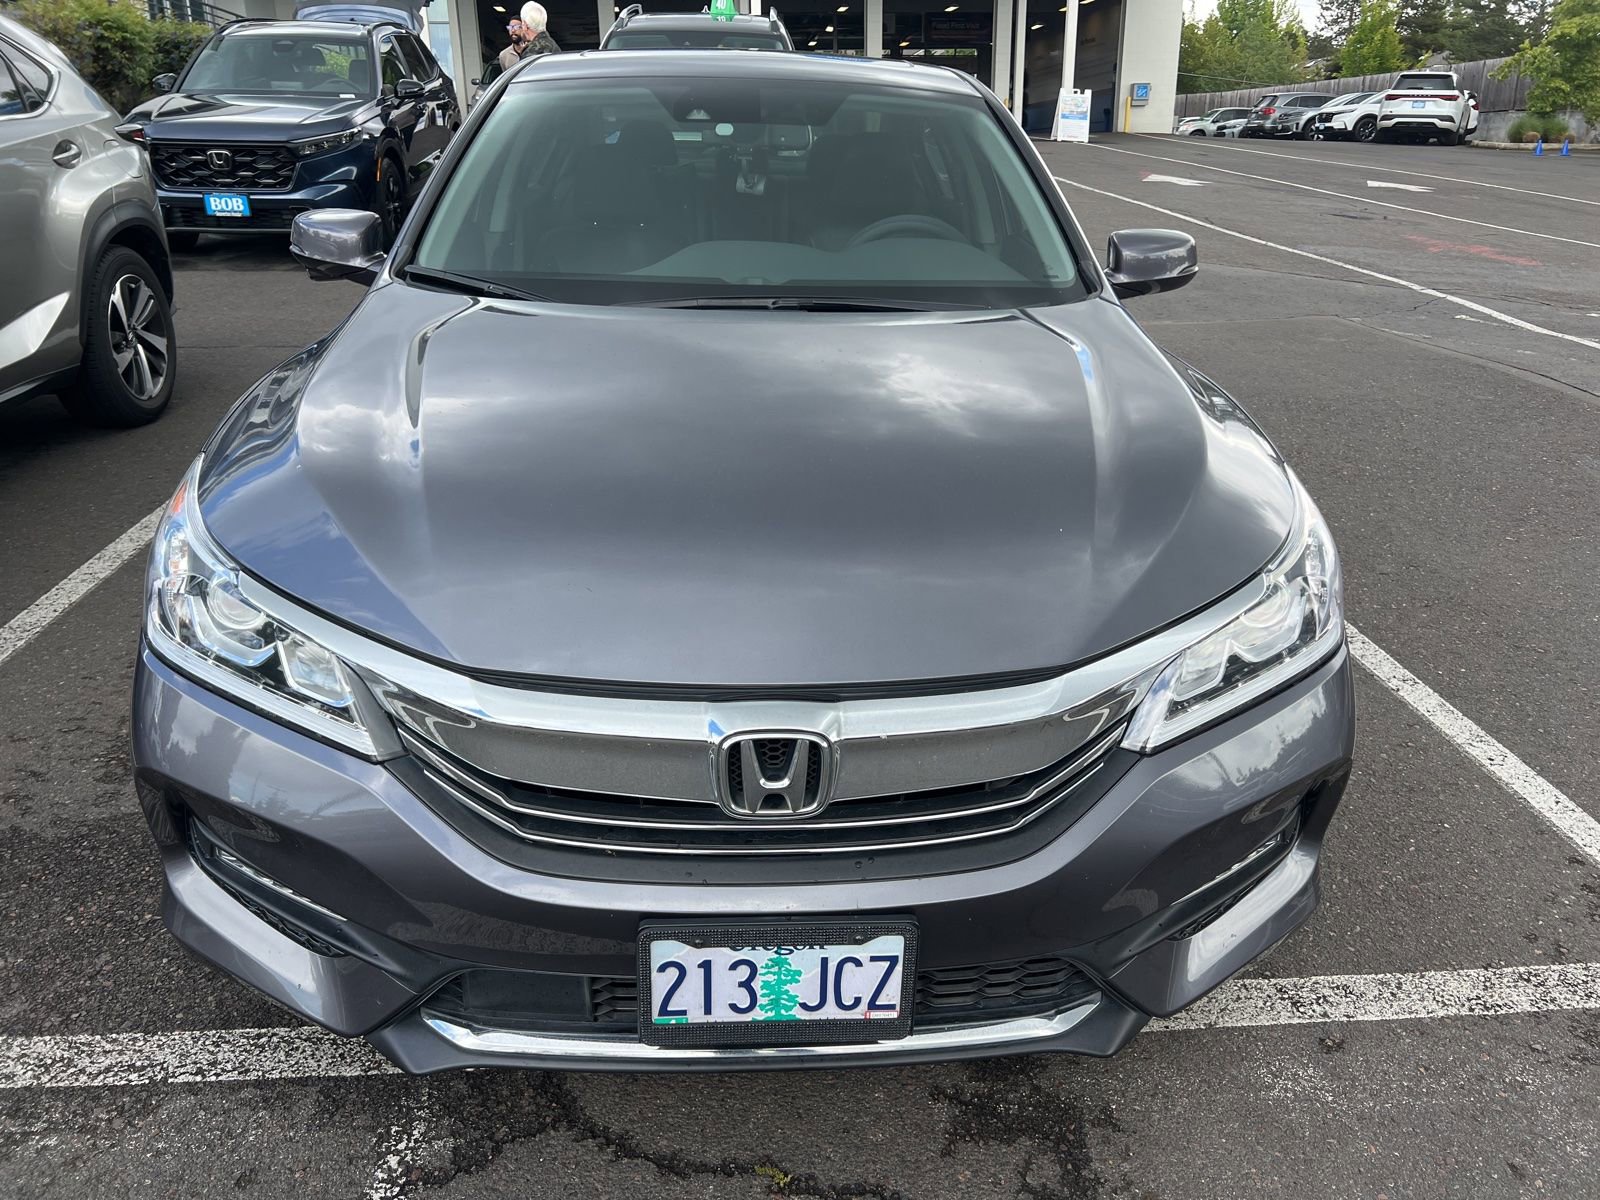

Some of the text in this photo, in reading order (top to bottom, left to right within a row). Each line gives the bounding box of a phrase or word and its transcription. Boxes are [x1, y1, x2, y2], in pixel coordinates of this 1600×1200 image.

[209, 197, 244, 210] BOB
[656, 955, 900, 1017] 213 JCZ
